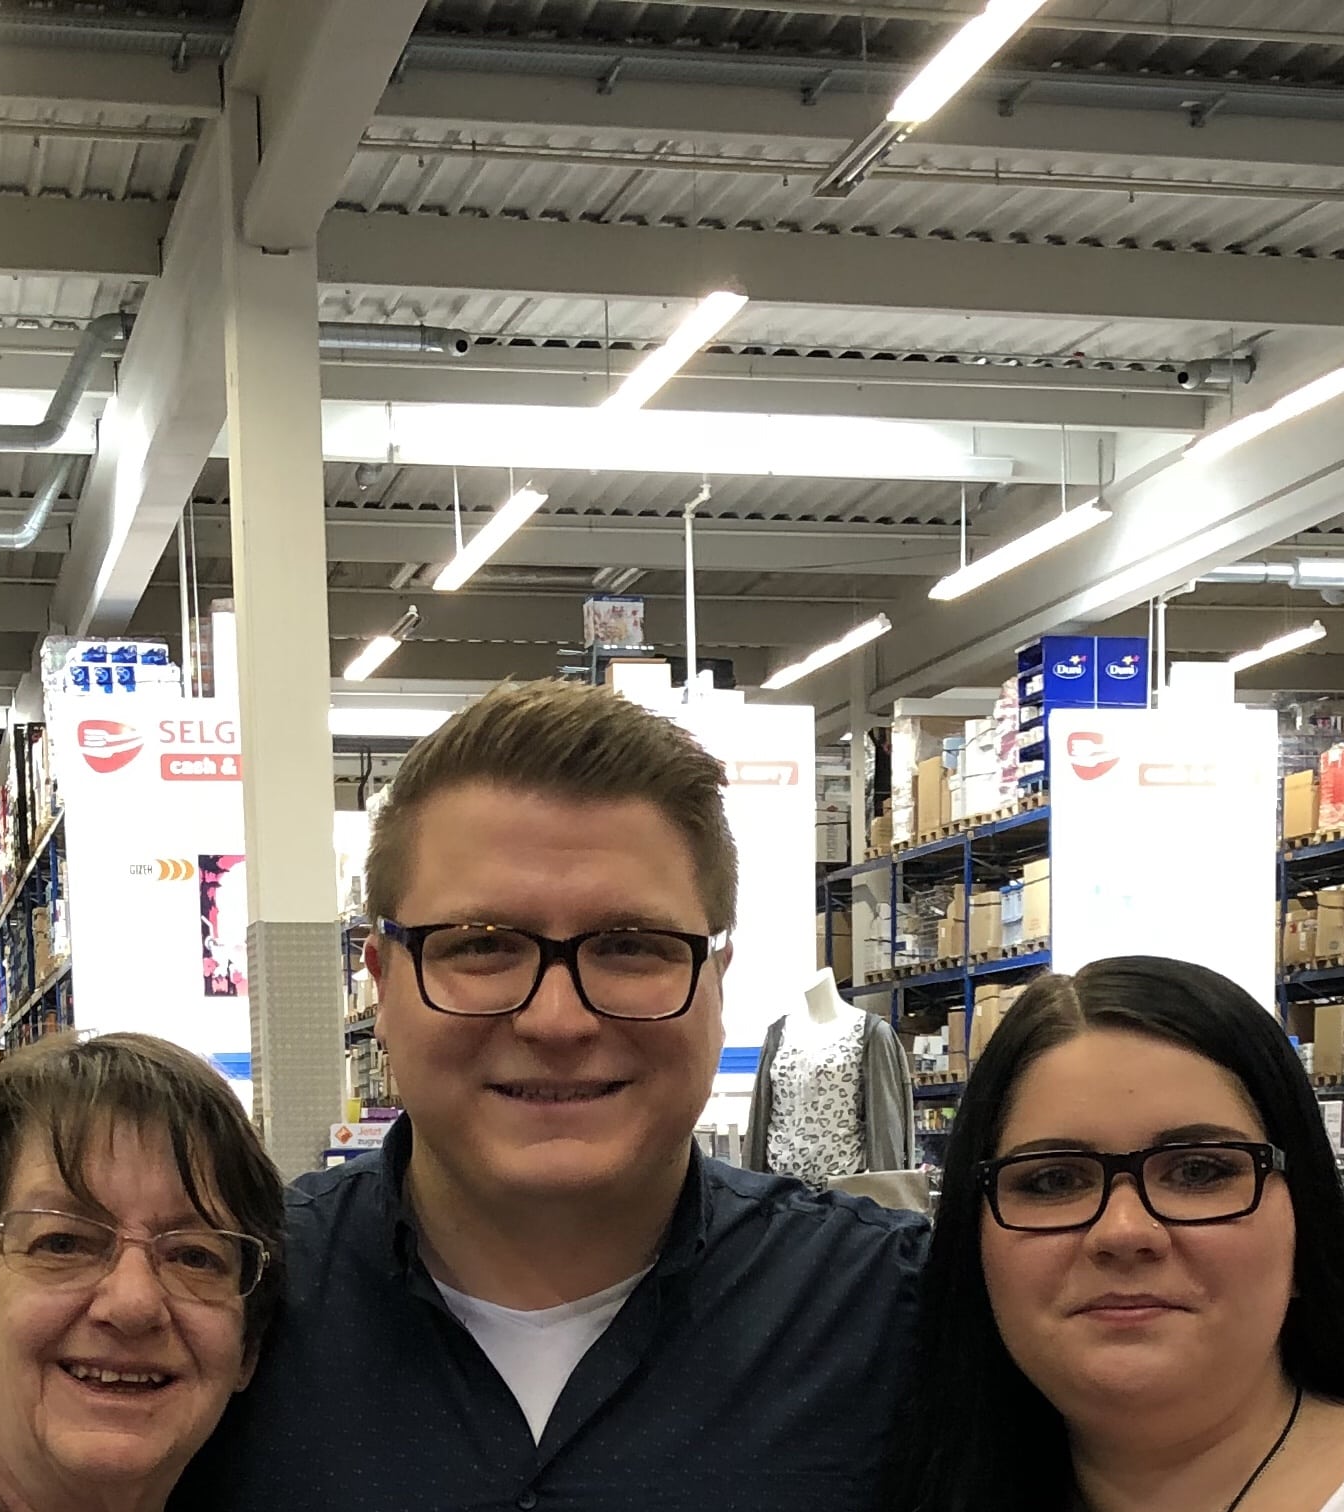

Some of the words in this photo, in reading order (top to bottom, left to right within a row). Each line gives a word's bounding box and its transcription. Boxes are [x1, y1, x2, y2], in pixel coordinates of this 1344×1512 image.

[1055, 663, 1084, 676] Duni
[1108, 663, 1136, 676] Duni
[169, 756, 217, 776] cash
